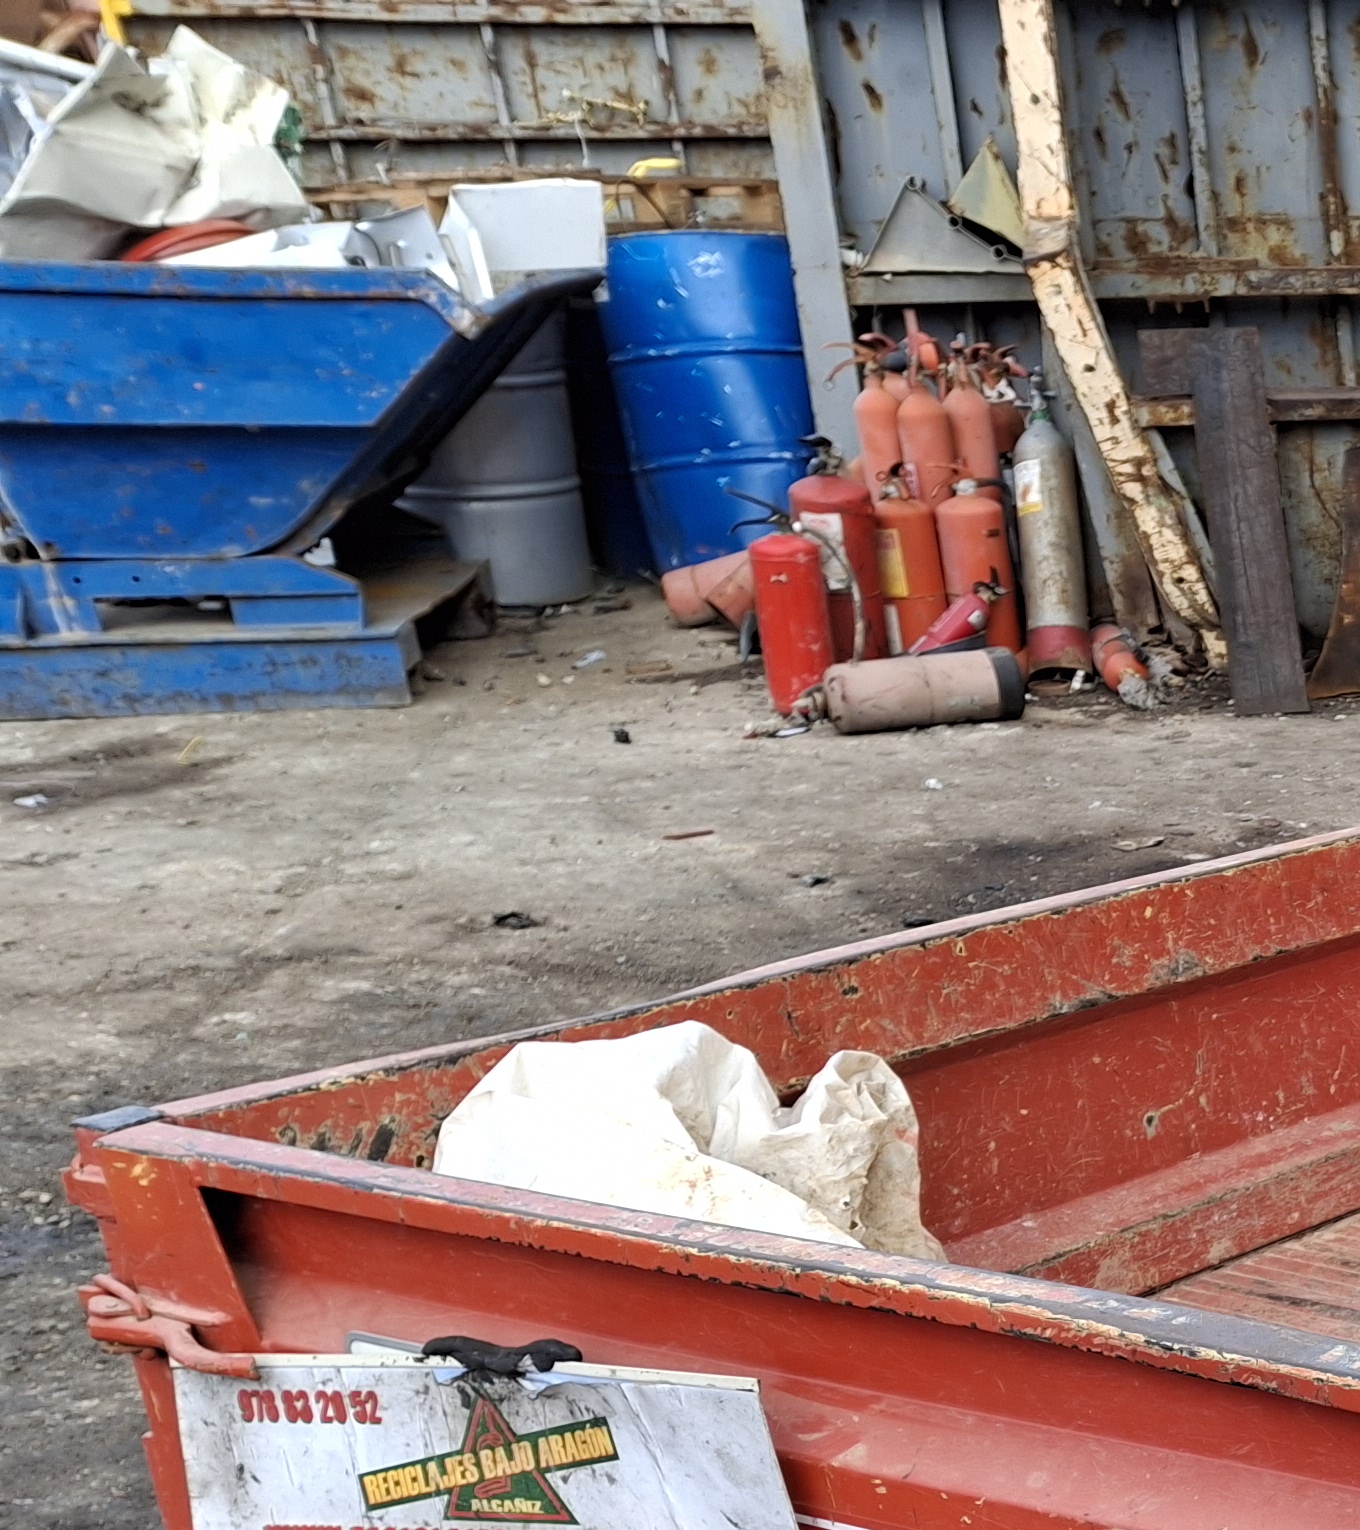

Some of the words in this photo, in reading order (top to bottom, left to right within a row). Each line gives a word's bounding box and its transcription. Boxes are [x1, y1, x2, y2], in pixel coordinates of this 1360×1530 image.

[237, 1389, 280, 1423] 978
[281, 1389, 314, 1424] 83
[314, 1390, 347, 1424] 20
[349, 1390, 383, 1425] 52
[362, 1452, 480, 1506] RECICLAJES
[479, 1440, 535, 1481] BAJO
[537, 1423, 615, 1468] ARAGÓN
[470, 1496, 544, 1514] ALCAÑIZ
